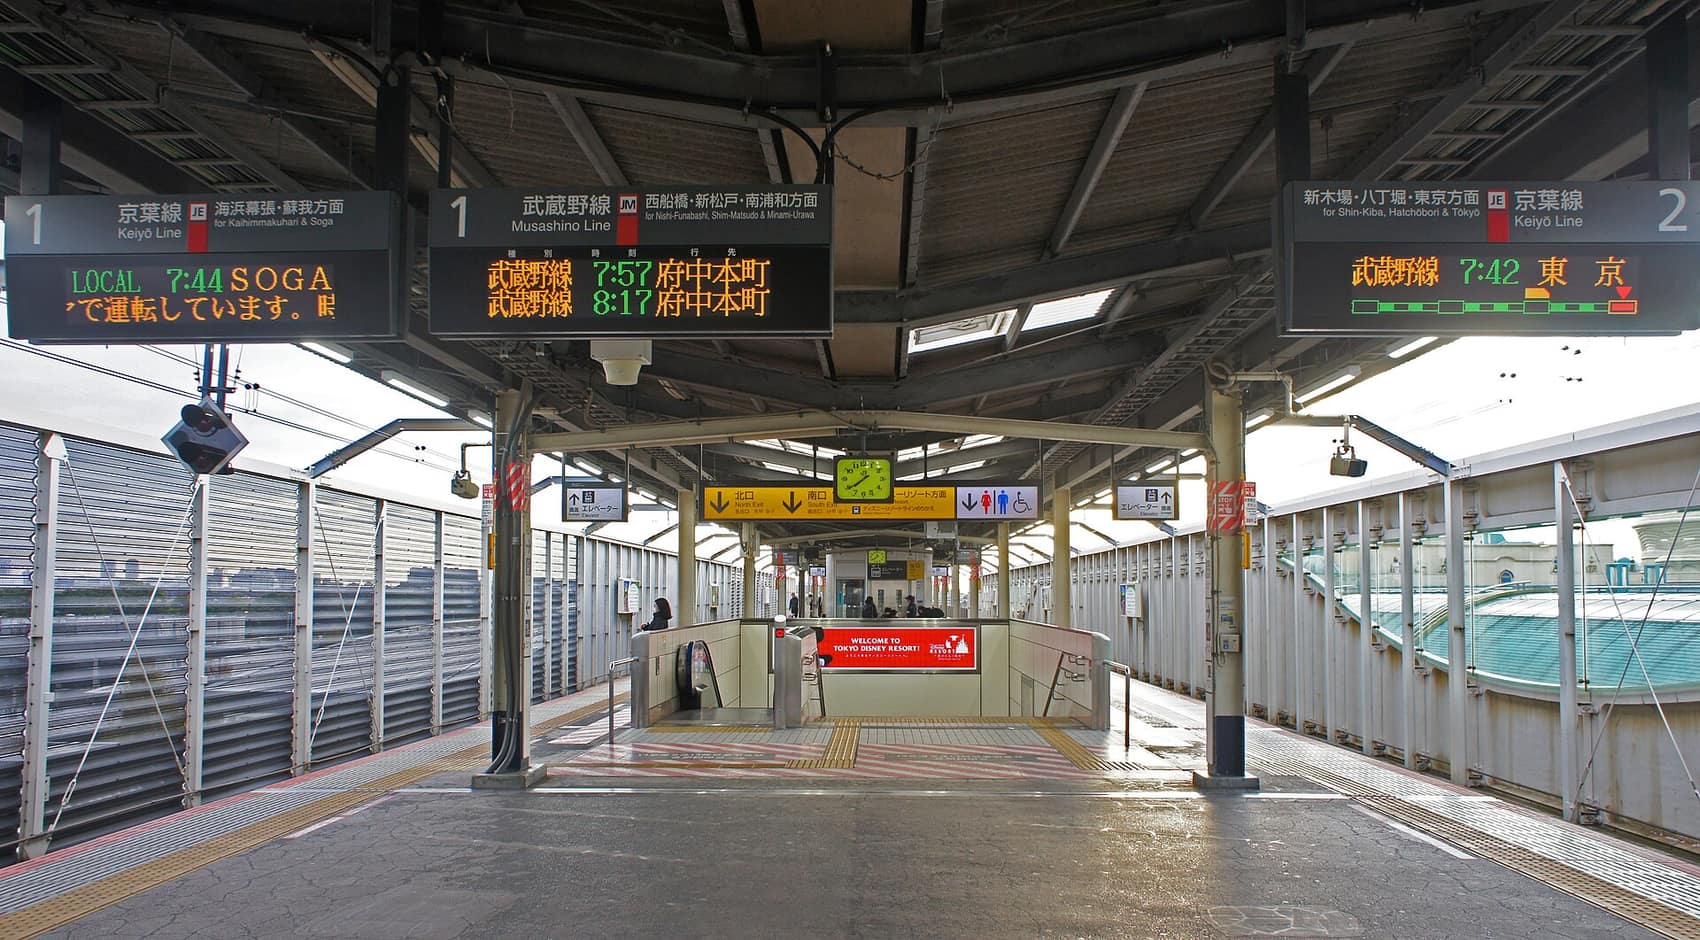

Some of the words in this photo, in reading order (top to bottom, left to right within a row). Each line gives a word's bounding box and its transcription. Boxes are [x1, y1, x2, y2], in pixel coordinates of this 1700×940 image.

[522, 194, 612, 216] 武蔵野線
[620, 199, 636, 210] JM
[645, 192, 818, 209] 西船橋・新松戸・南浦和方面
[1303, 189, 1480, 206] 新木場・八丁堀・東京方面
[1514, 189, 1584, 212] 京葉線
[117, 202, 182, 224] 京葉線
[214, 199, 344, 217] 海浜幕張・蘇我方面
[760, 210, 766, 219] &
[1323, 207, 1335, 217] for
[1338, 207, 1386, 218] Shin-Kiba,
[1442, 207, 1449, 217] &
[1658, 187, 1688, 232] 2
[25, 203, 42, 245] 1
[214, 217, 226, 228] for
[301, 217, 308, 226] &
[310, 216, 334, 229] Soga
[450, 196, 467, 238] 1
[511, 219, 580, 232] Musashino
[584, 219, 611, 231] Line
[1514, 214, 1551, 231] Keiyō
[1555, 214, 1584, 228] Line
[117, 226, 153, 242] Keiyō
[156, 226, 182, 239] Line
[71, 269, 142, 294] LOCAL
[166, 268, 223, 293] 7:44
[230, 265, 333, 292] SOGA
[487, 259, 573, 290] 武蔵野線
[593, 261, 652, 287] 7:57
[655, 258, 771, 289] 府中本町
[1351, 255, 1440, 288] 武蔵野線
[1460, 258, 1521, 285] 7:42
[487, 288, 573, 318] 武蔵野線
[593, 289, 652, 316] 8:17
[655, 287, 771, 318] 府中本町
[735, 490, 754, 501] 北口
[808, 490, 827, 501] 南口
[581, 504, 619, 513] エレベーター
[1120, 503, 1159, 511] エレベーター
